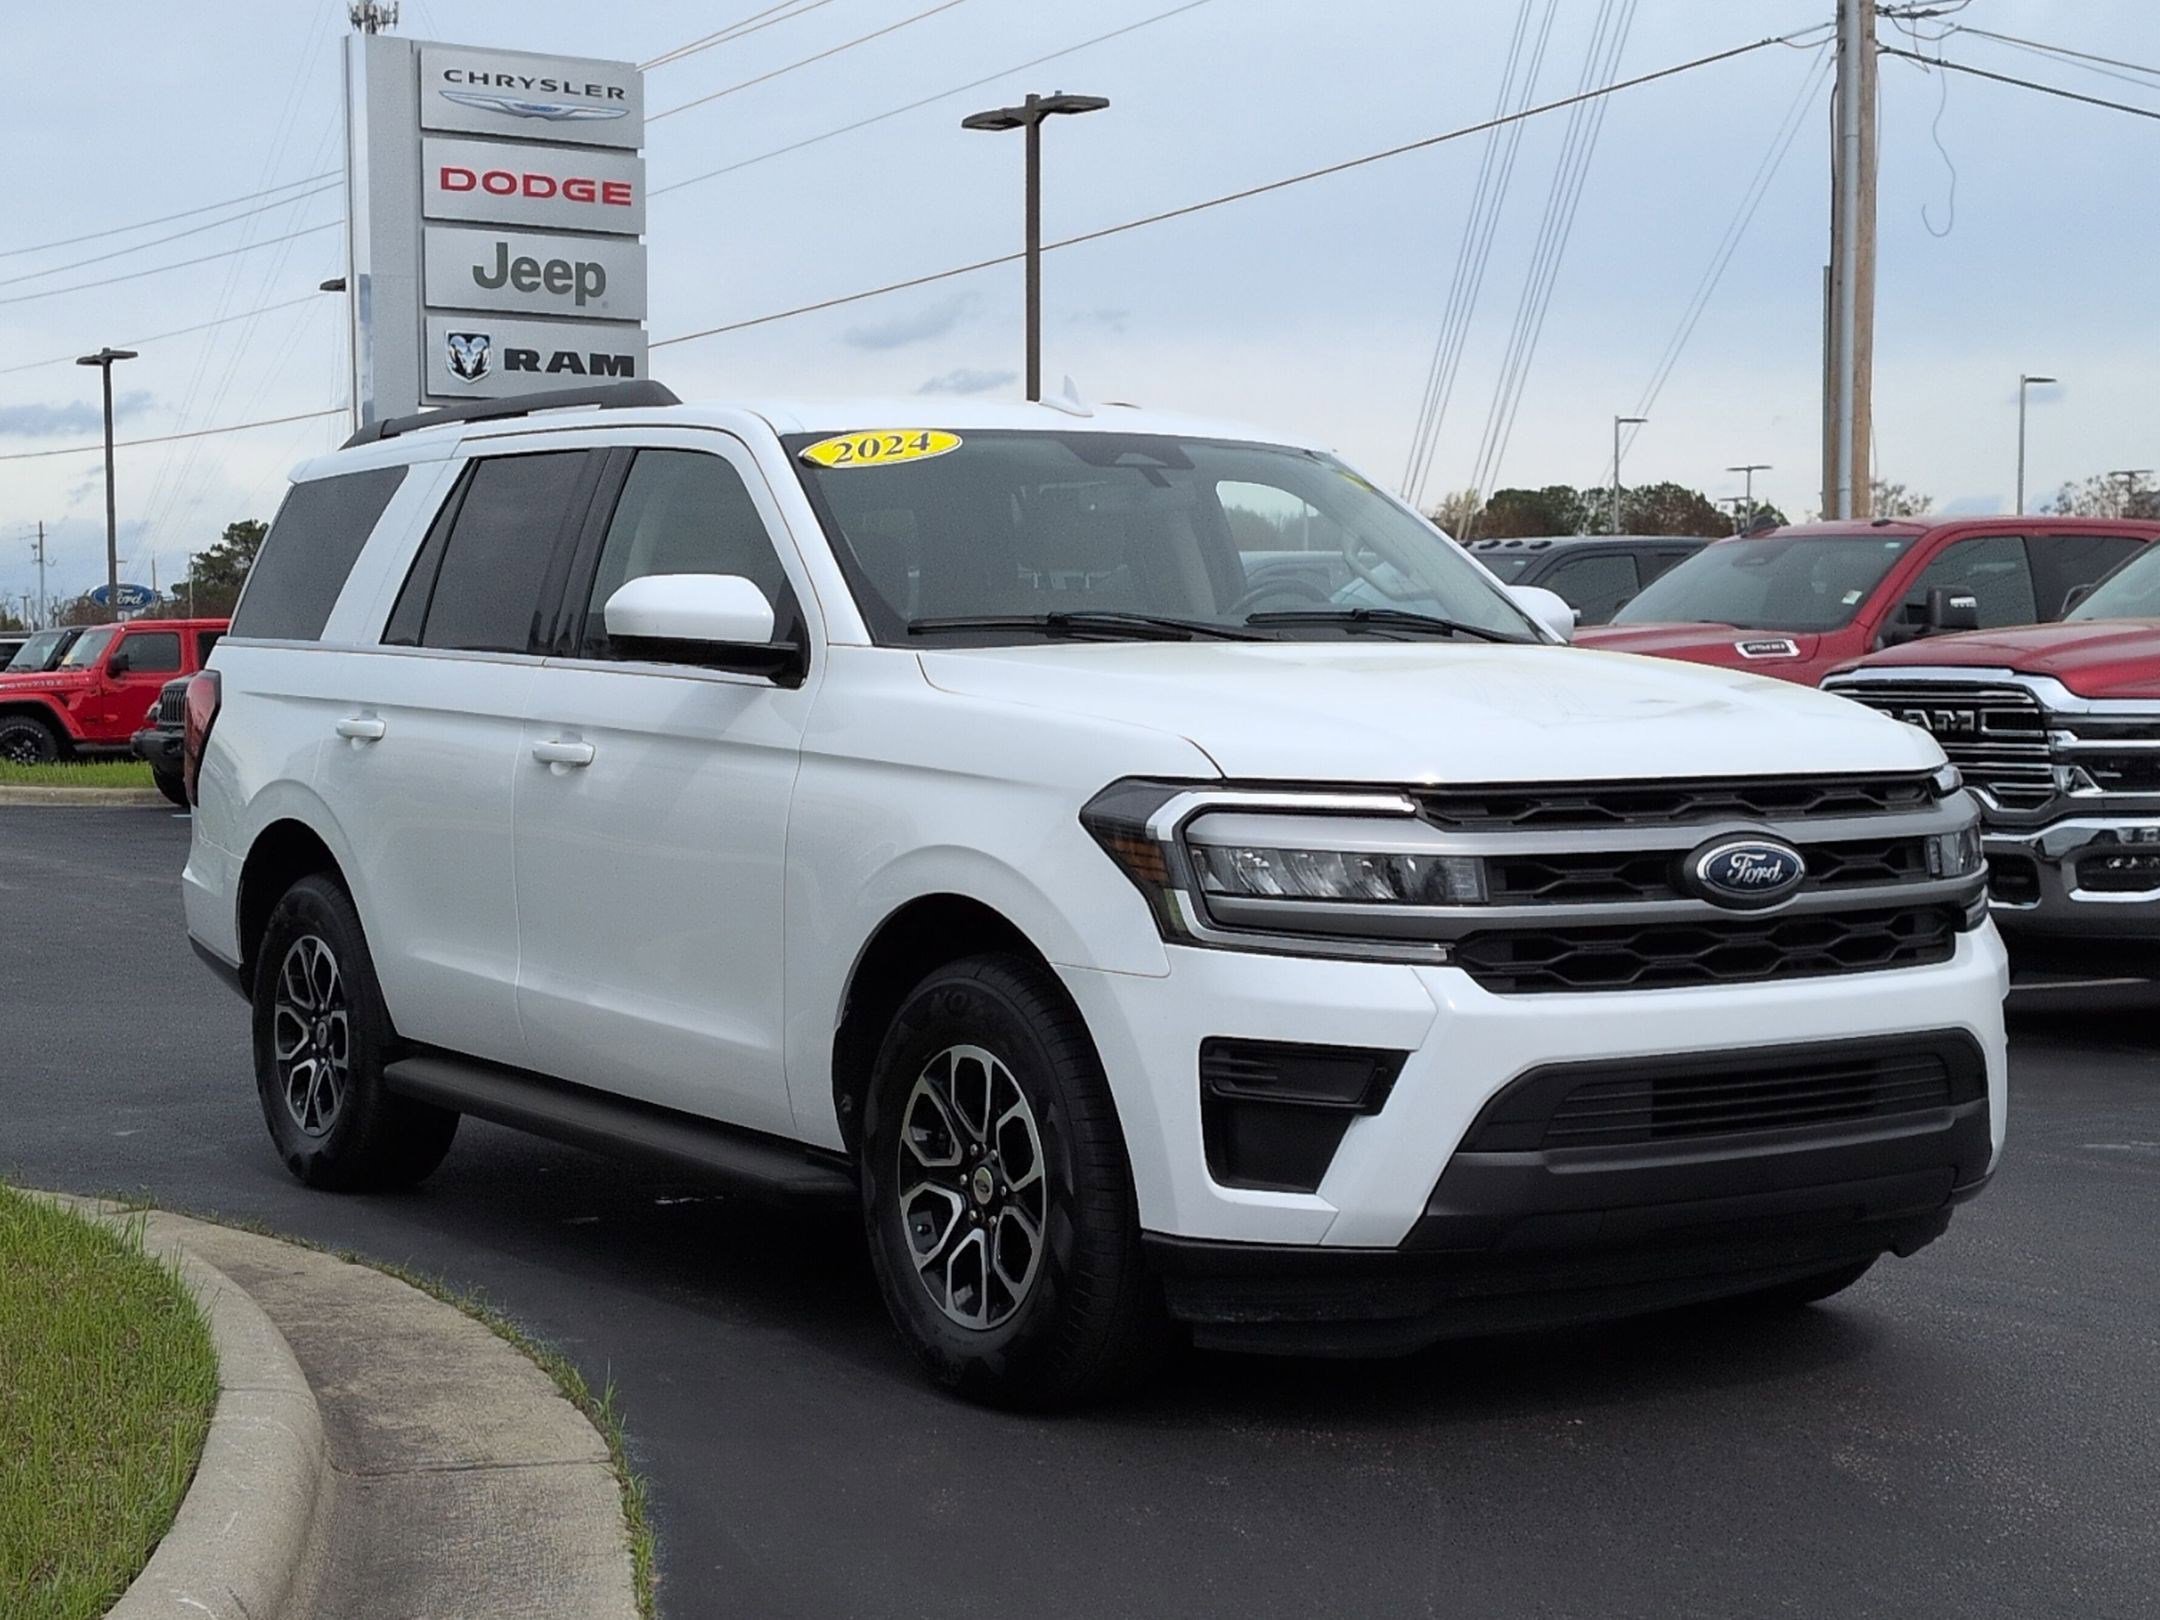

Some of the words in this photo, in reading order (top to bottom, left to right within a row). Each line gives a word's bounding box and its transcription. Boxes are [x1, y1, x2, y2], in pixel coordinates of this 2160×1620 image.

[443, 69, 625, 100] CHRYSLER
[440, 167, 632, 206] DODGE
[472, 242, 607, 306] Jeep
[504, 348, 635, 378] RAM
[833, 432, 931, 463] 2024
[1876, 709, 1975, 731] AM
[1726, 853, 1784, 884] Ford
